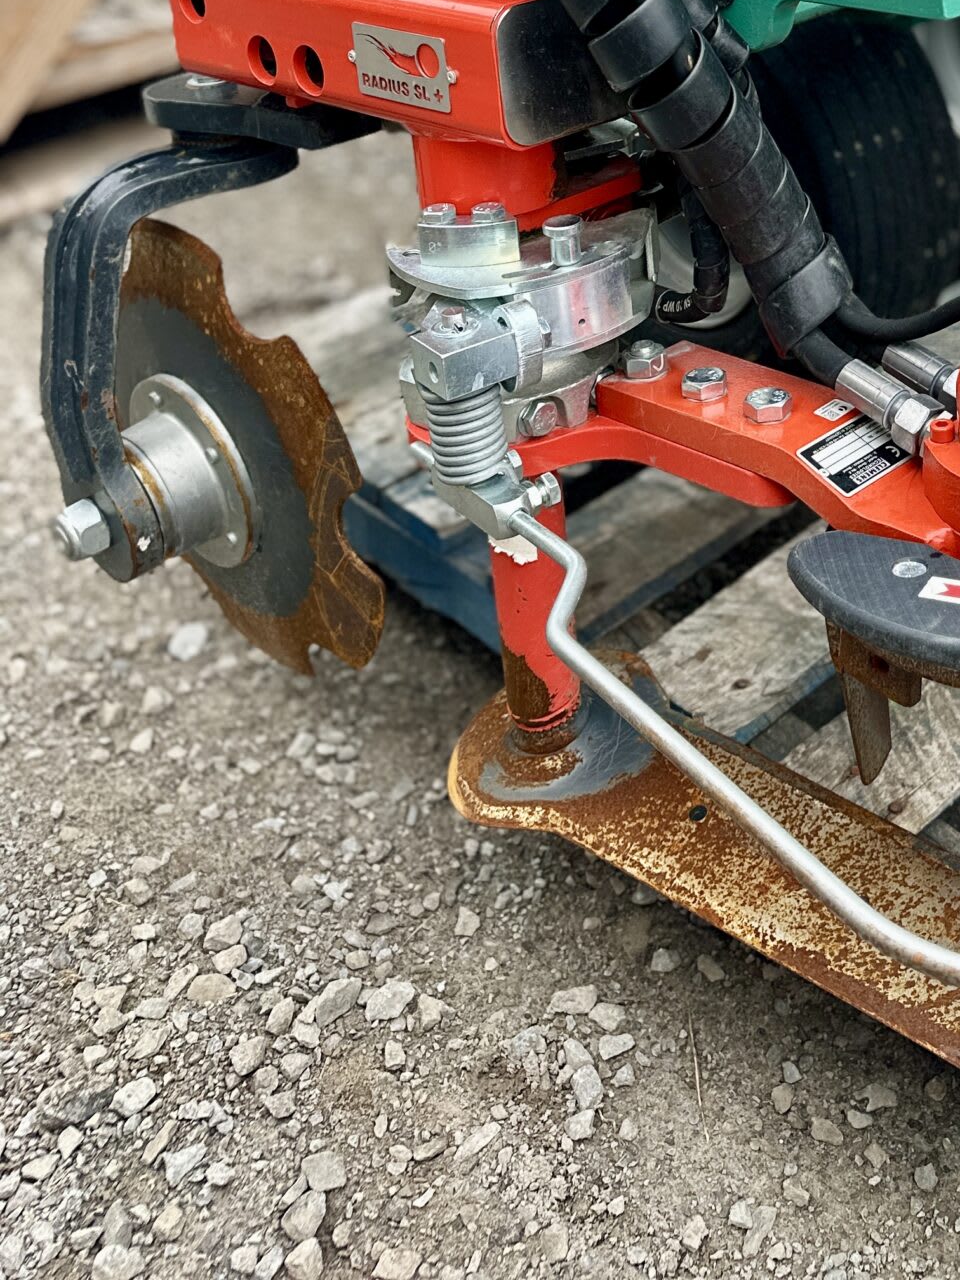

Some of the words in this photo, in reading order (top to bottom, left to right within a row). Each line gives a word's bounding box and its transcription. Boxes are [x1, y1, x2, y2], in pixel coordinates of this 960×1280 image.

[362, 72, 410, 97] RADIUS
[414, 84, 431, 101] SL
[662, 300, 675, 313] WP
